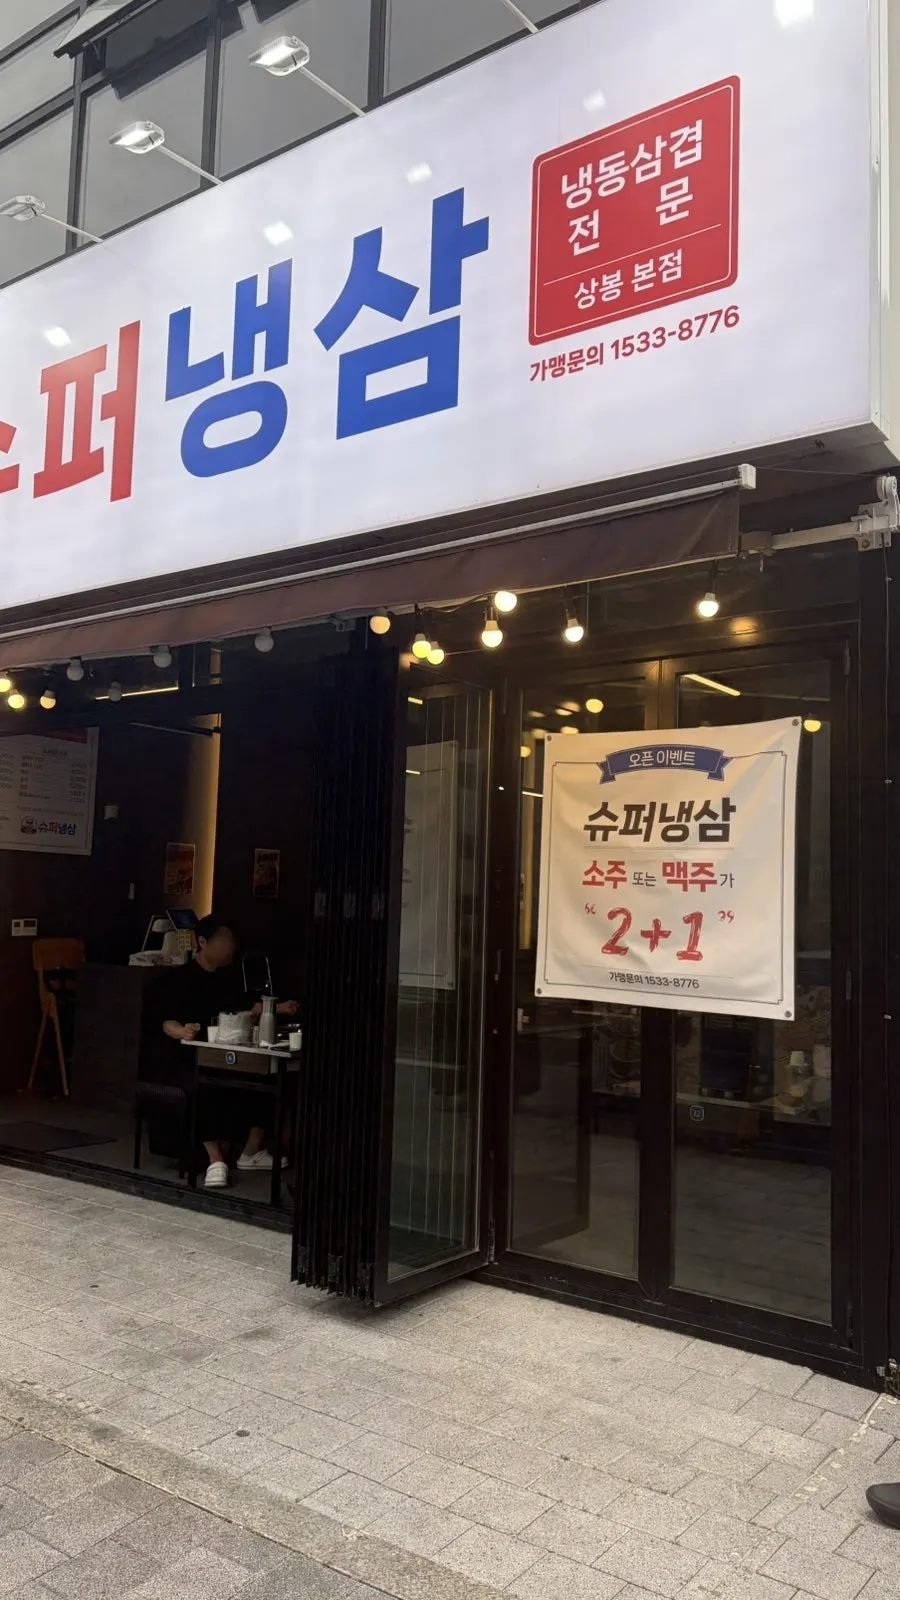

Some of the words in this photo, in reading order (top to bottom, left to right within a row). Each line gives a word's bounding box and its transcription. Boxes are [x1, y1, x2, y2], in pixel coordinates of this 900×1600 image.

[561, 119, 703, 209] 냉동삼겹
[574, 269, 624, 310] 상봉
[631, 249, 683, 293] 본점
[0, 187, 490, 502] 퍼냉삼
[529, 342, 605, 382] 가맹문의
[610, 305, 740, 360] 1533-8776
[628, 749, 654, 768] 오픈
[656, 749, 696, 767] 이벤트
[583, 797, 737, 843] 슈퍼냉삼
[582, 860, 628, 889] 소주
[631, 871, 657, 888] 또는
[609, 971, 644, 985] 가맹문의
[644, 975, 700, 989] 1533-8776
